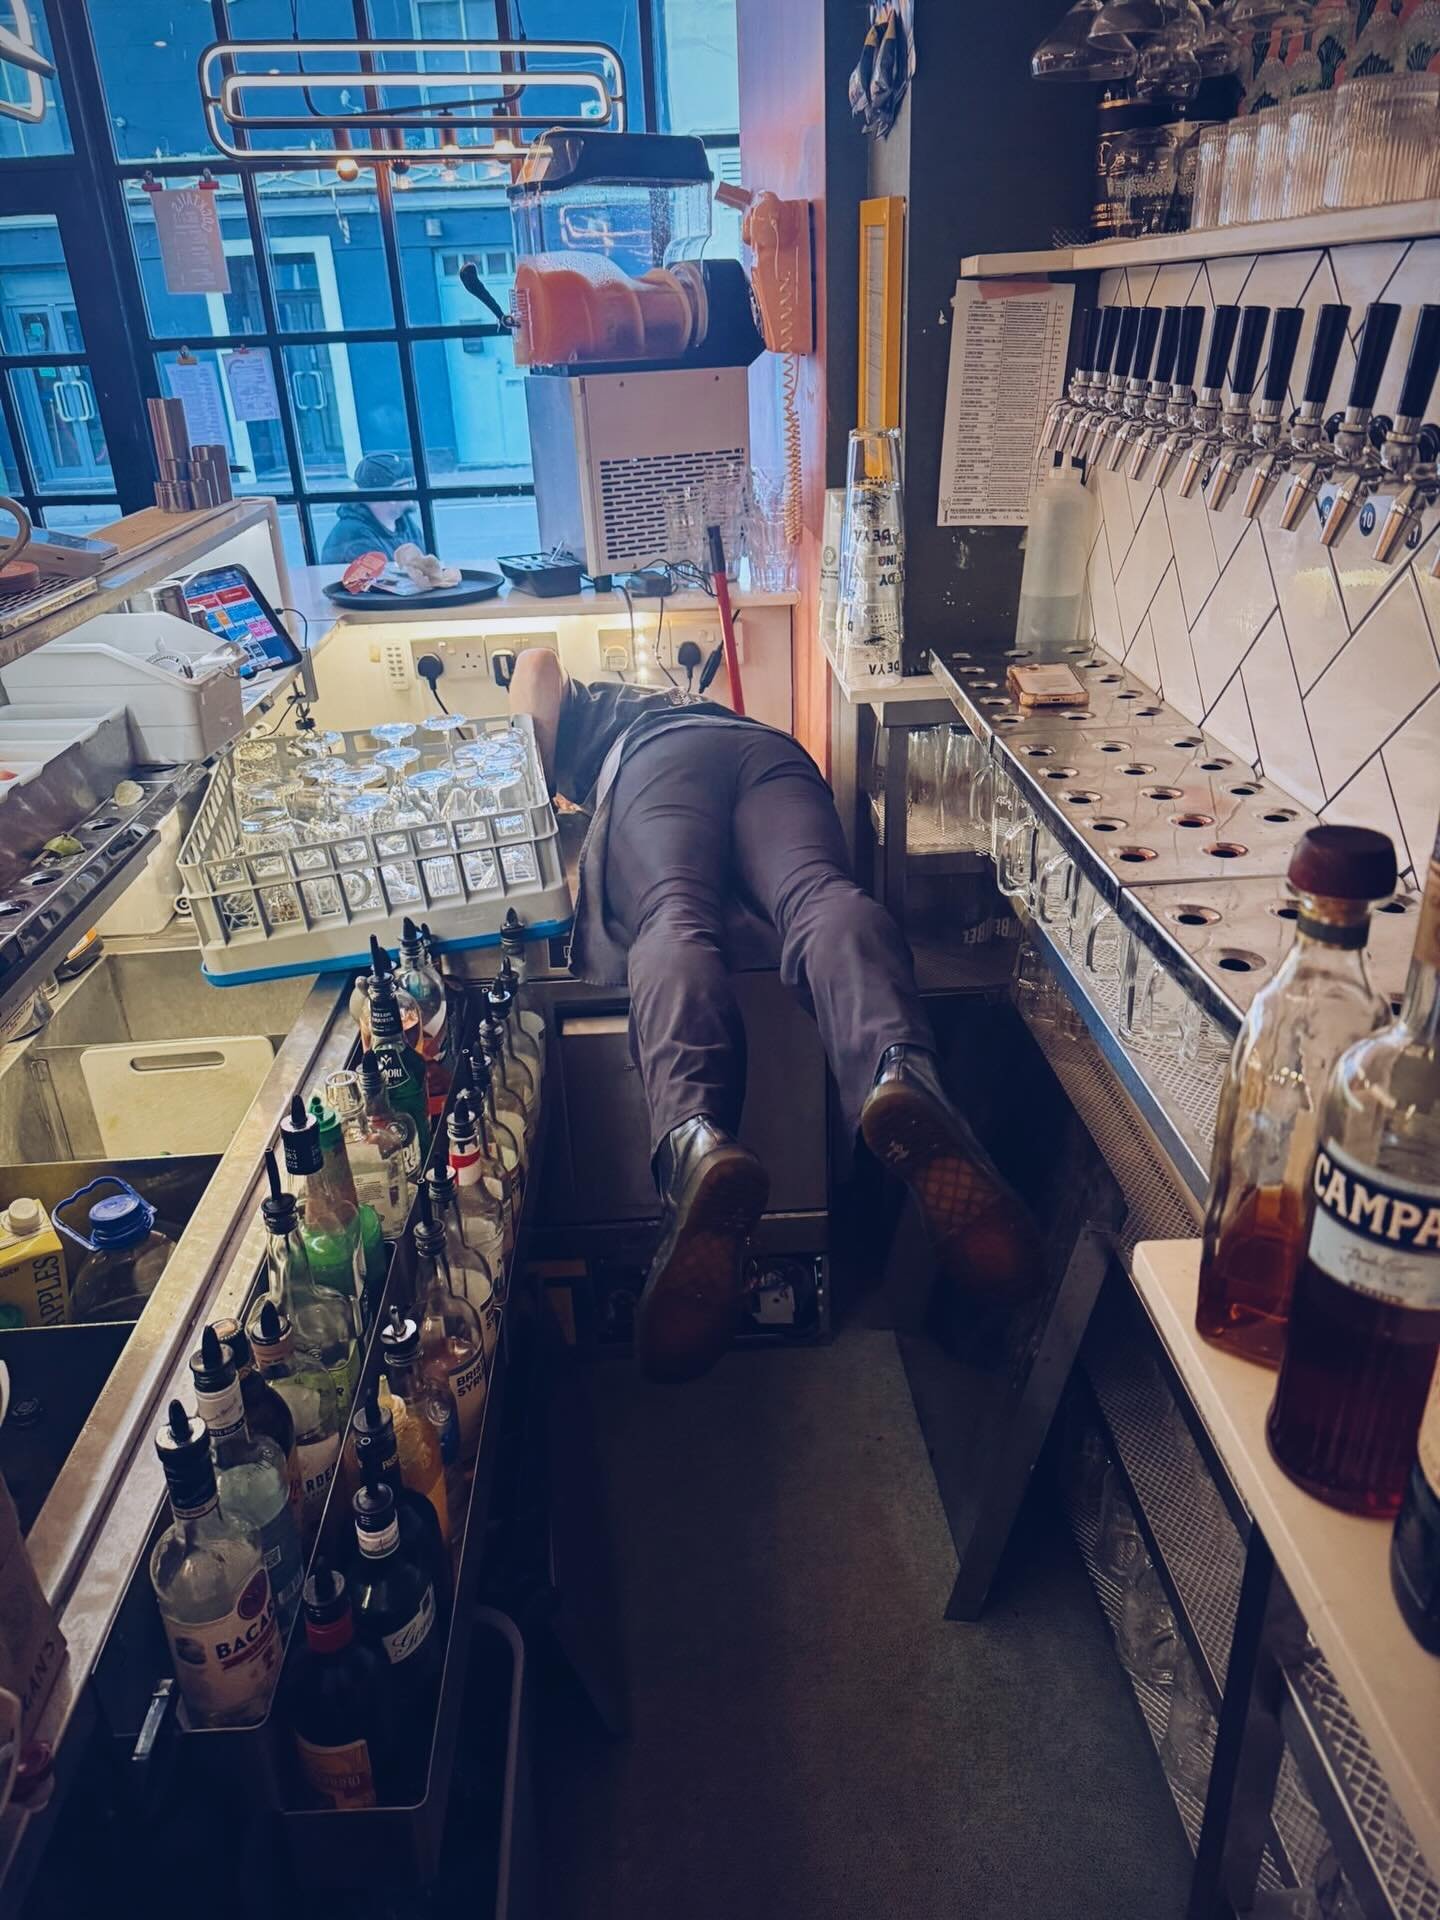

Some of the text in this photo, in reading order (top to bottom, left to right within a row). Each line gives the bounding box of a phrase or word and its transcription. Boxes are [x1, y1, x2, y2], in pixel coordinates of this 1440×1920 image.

[1362, 511, 1373, 528] 10
[854, 529, 891, 542] DEYA
[869, 660, 900, 676] DEYA
[1313, 1152, 1440, 1249] CAMPA
